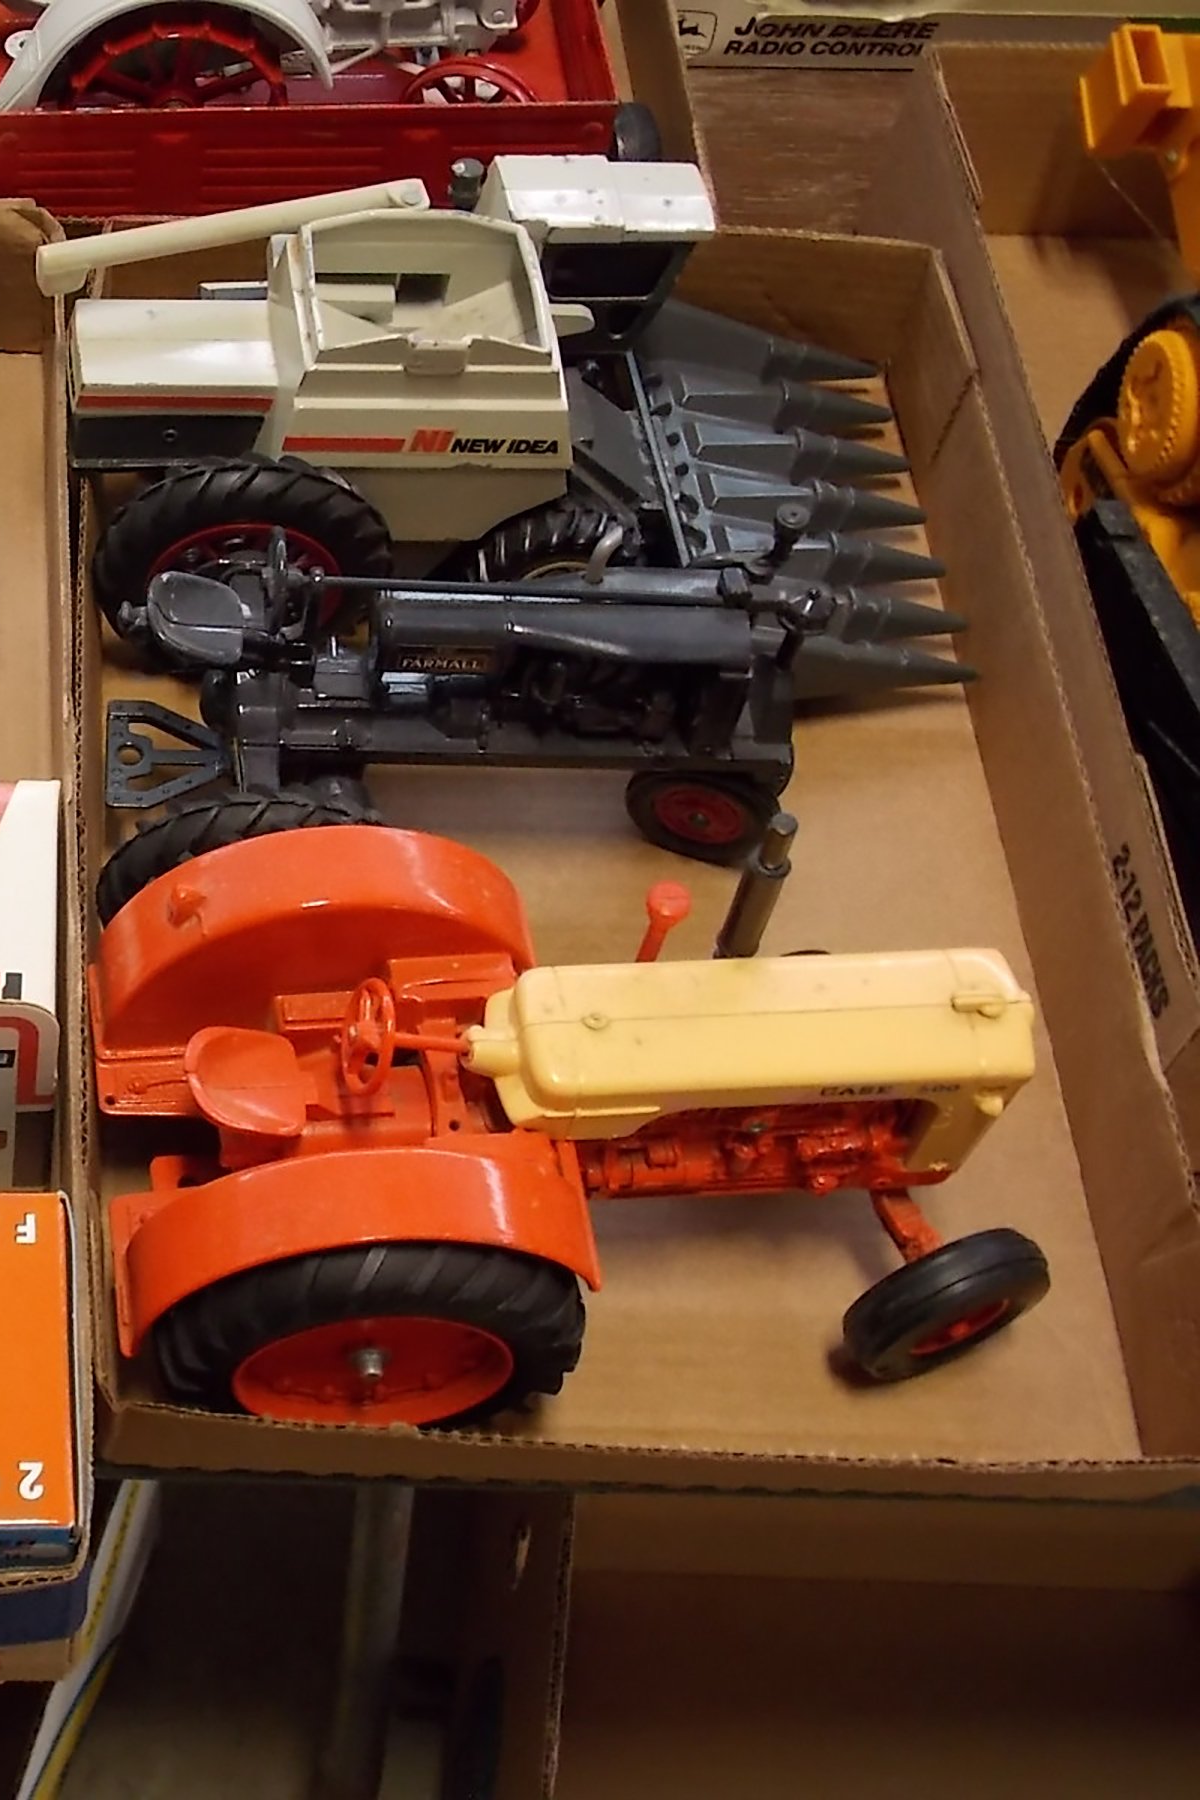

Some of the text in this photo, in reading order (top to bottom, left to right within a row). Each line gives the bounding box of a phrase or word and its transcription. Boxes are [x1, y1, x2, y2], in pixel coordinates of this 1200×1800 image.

[734, 16, 940, 39] JOHN DEERE
[723, 40, 806, 55] RADIO
[450, 438, 559, 454] NEW IDEA
[401, 658, 479, 669] FARMALL
[1111, 841, 1142, 924] 2-12
[820, 1085, 894, 1097] CASE
